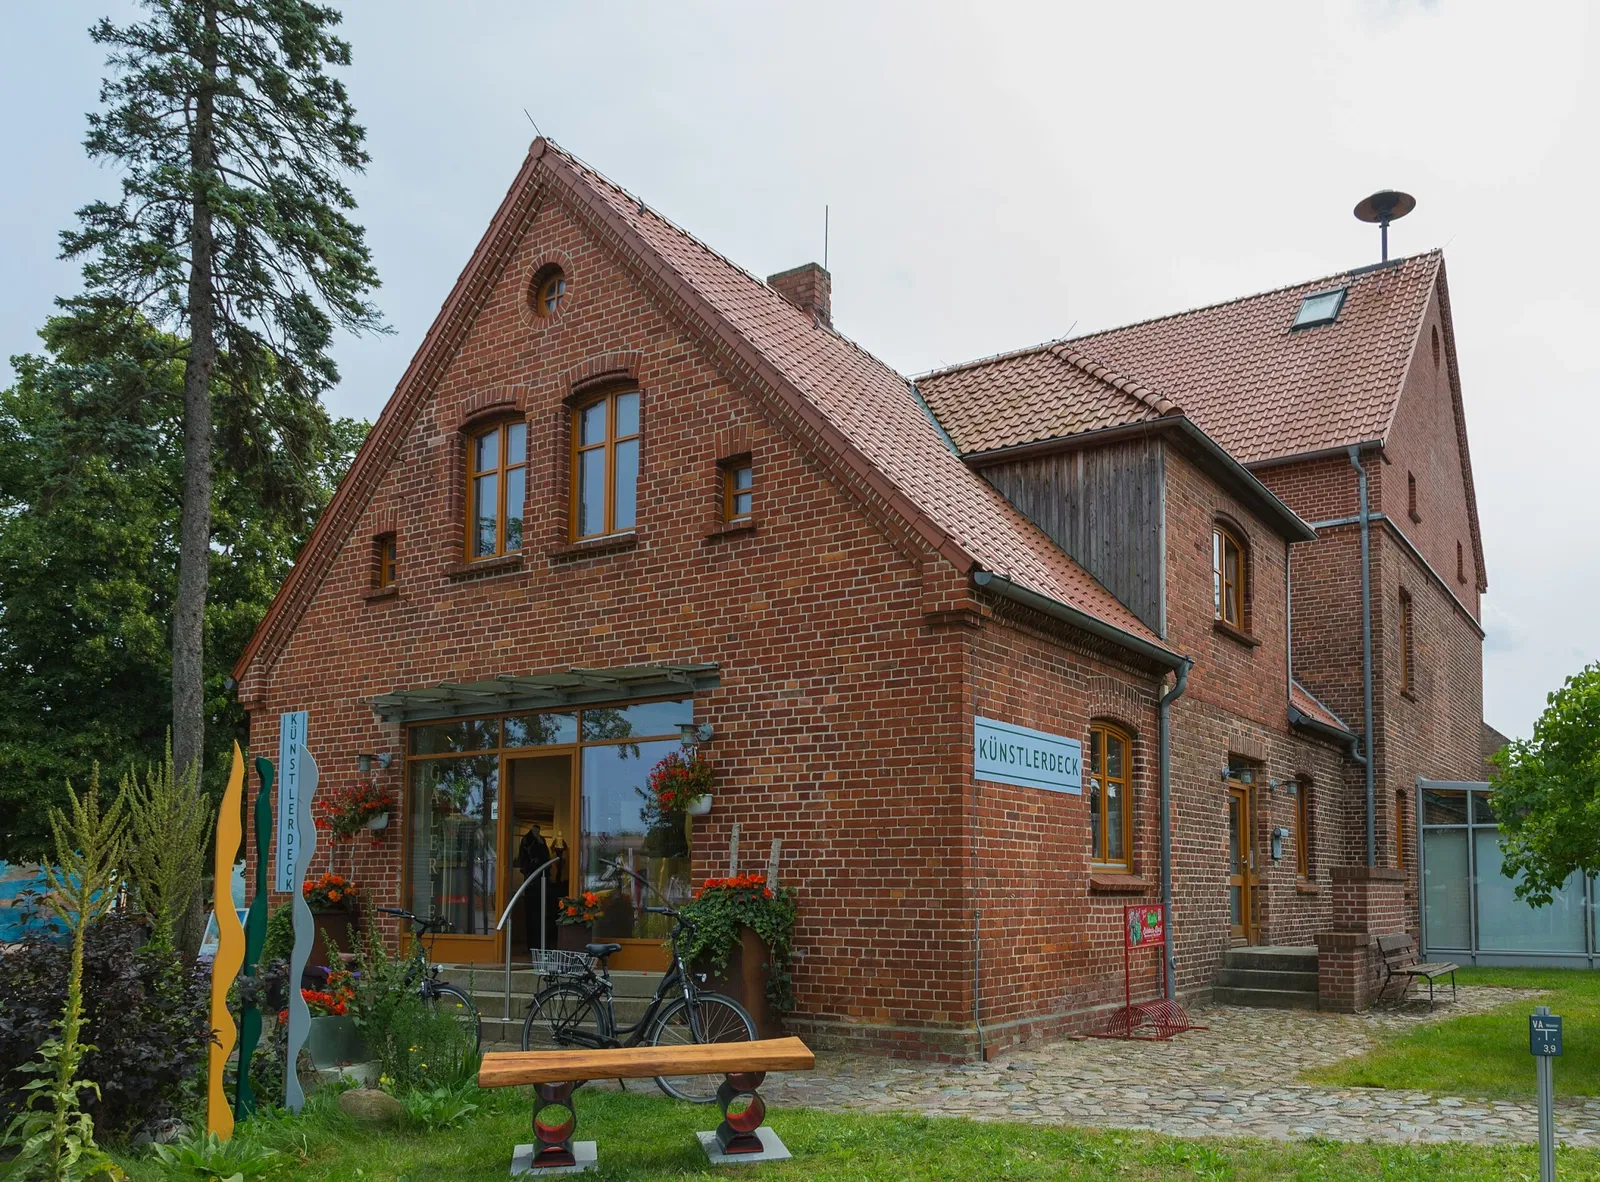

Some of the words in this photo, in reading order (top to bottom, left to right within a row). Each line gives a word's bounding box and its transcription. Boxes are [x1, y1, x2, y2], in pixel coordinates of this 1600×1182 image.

[286, 714, 298, 891] KÜNSTLERDECK
[979, 736, 1079, 776] KÜNSTLERDECK
[428, 765, 440, 921] GALERIE
[1532, 1020, 1543, 1029] VA
